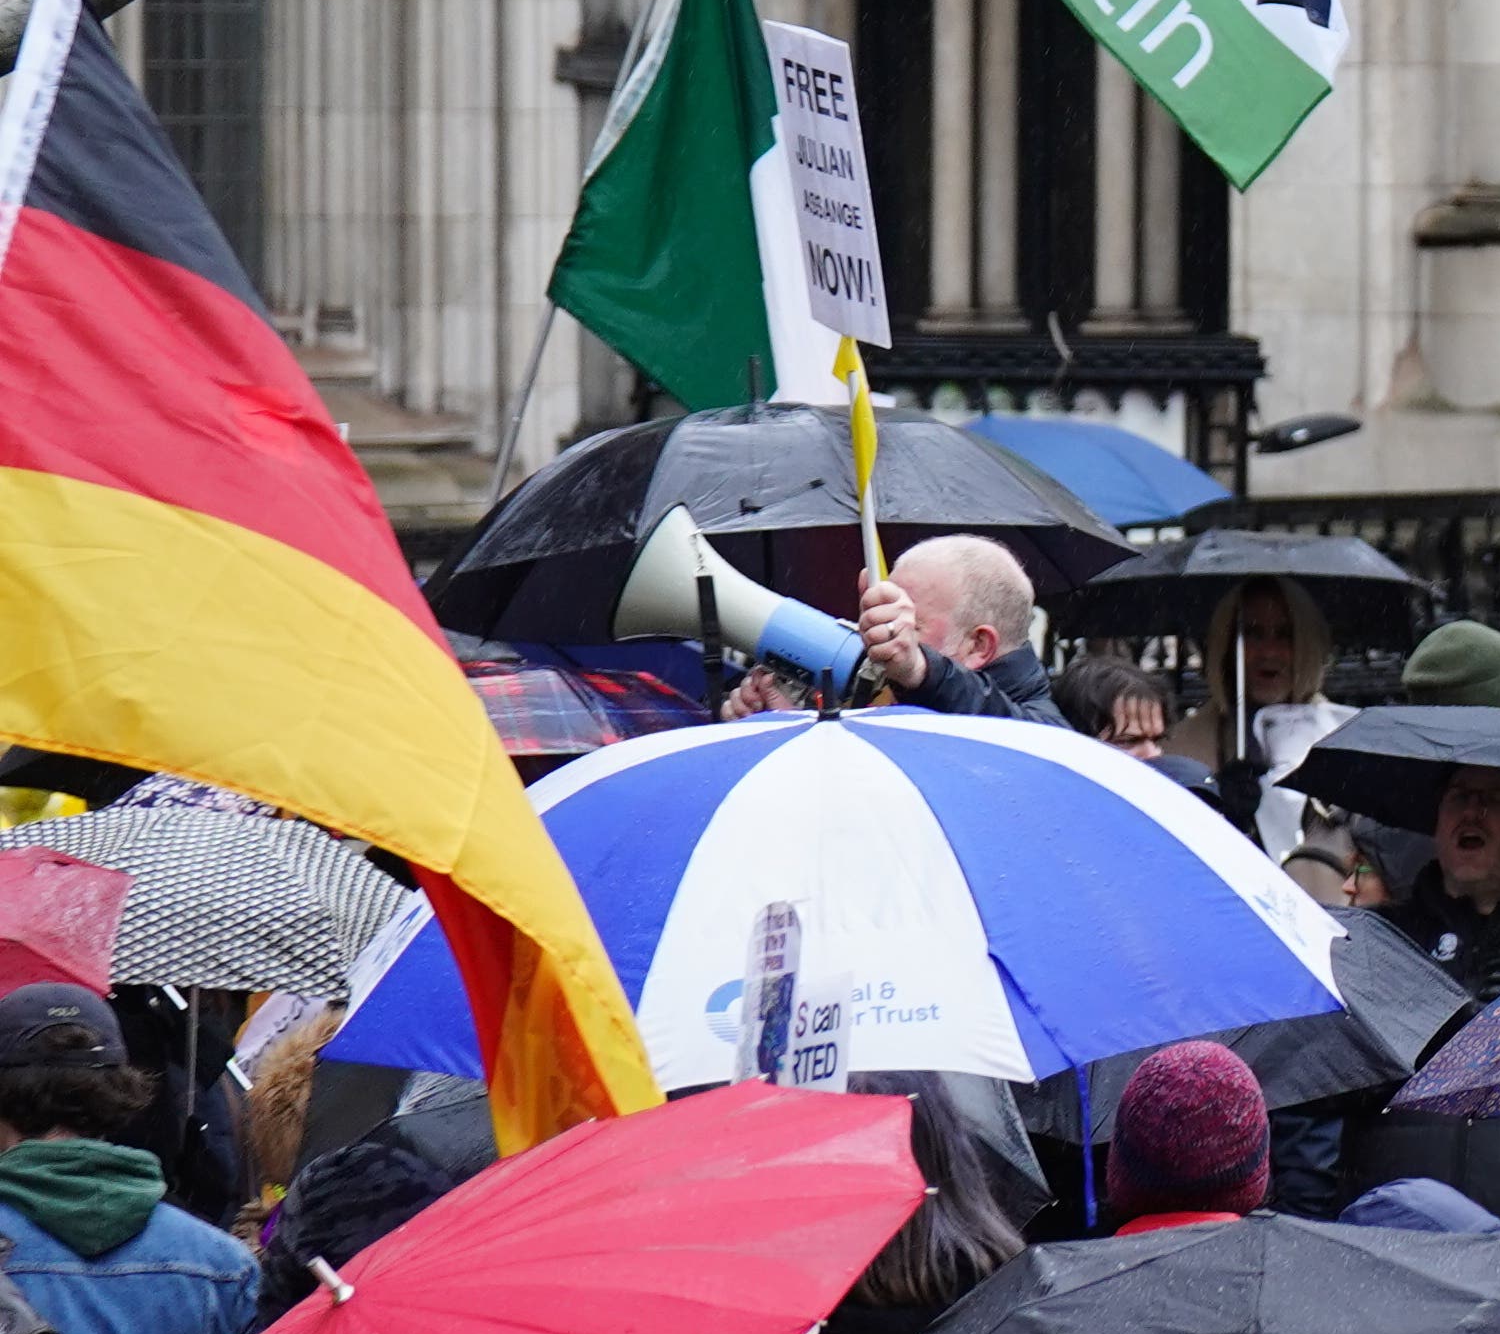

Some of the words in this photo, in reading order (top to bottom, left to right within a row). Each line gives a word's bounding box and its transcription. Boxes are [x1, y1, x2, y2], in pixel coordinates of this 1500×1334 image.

[782, 58, 848, 122] FREE
[796, 136, 855, 181] JULIAN
[803, 187, 864, 230] ASSANGE
[807, 240, 877, 307] NOW!
[812, 1001, 842, 1035] can
[871, 1003, 940, 1025] Trust
